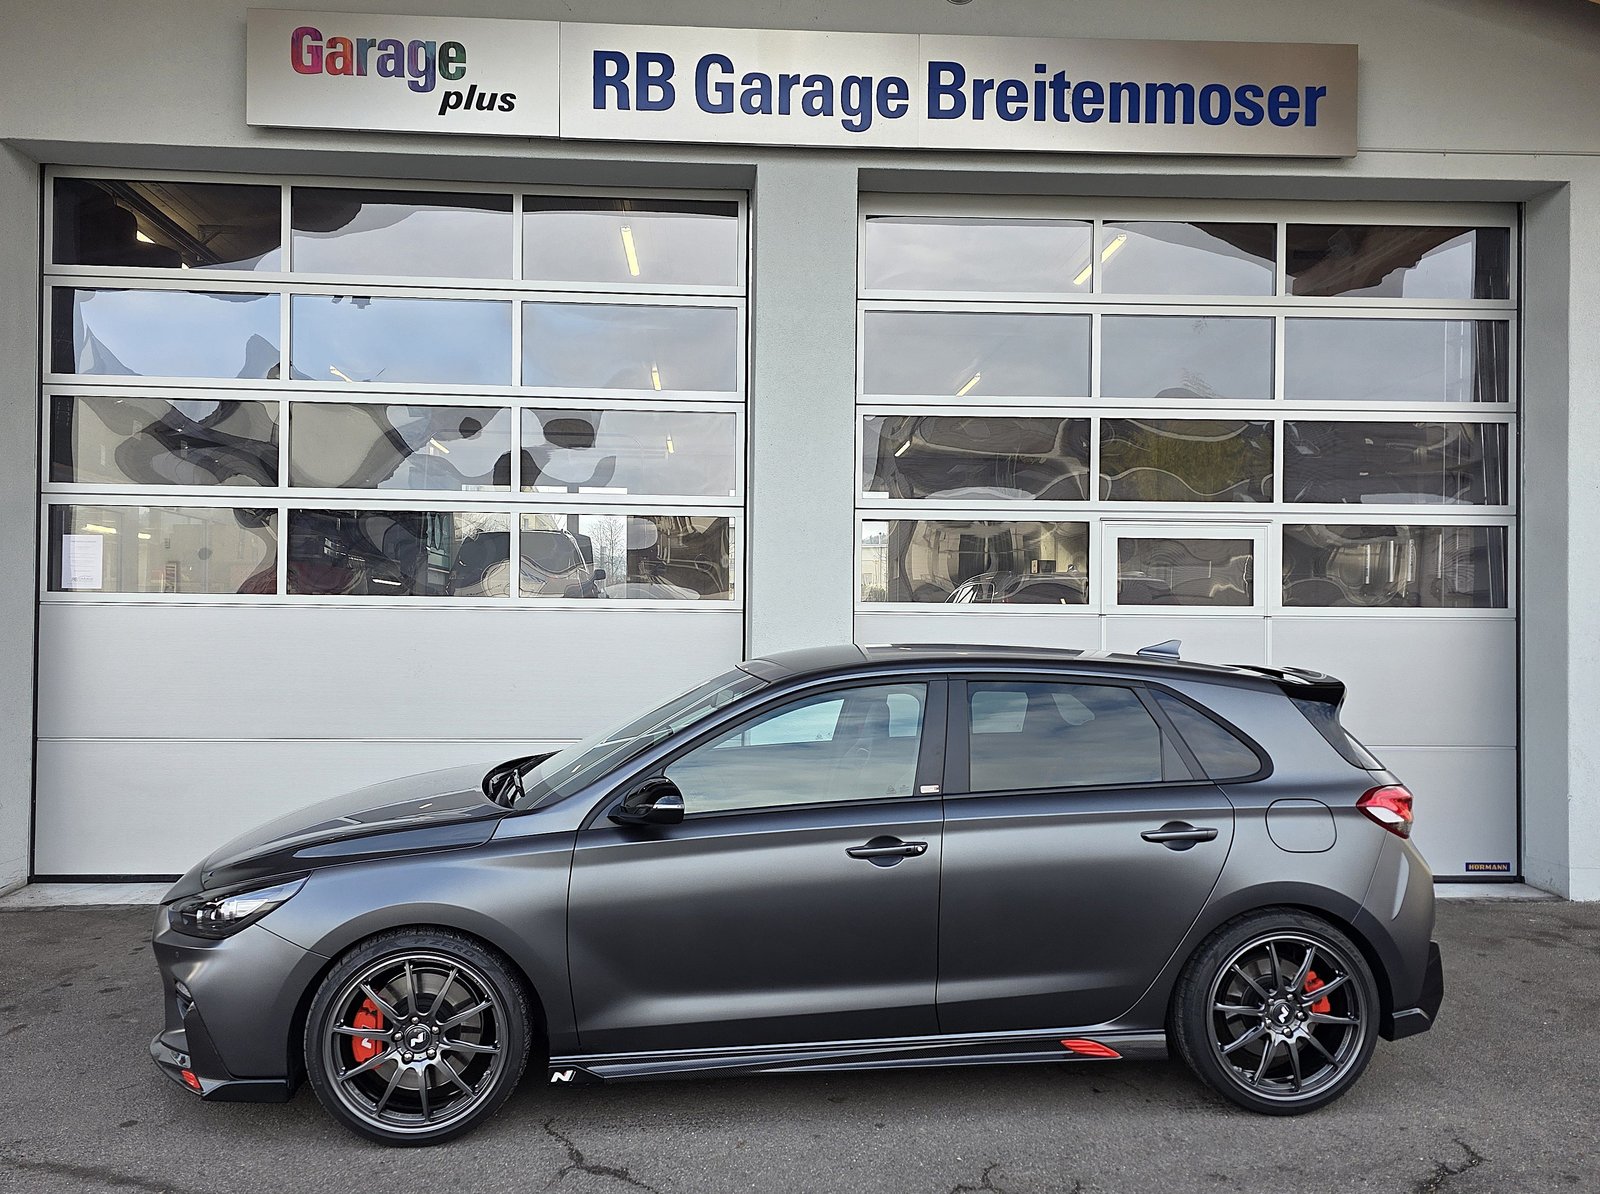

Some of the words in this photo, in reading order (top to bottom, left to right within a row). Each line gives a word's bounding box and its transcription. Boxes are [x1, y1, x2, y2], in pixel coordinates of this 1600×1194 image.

[290, 26, 467, 93] Garage
[592, 50, 676, 112] RB
[695, 53, 909, 133] Garage
[927, 61, 1327, 127] Breitenmoser
[438, 84, 517, 116] plus
